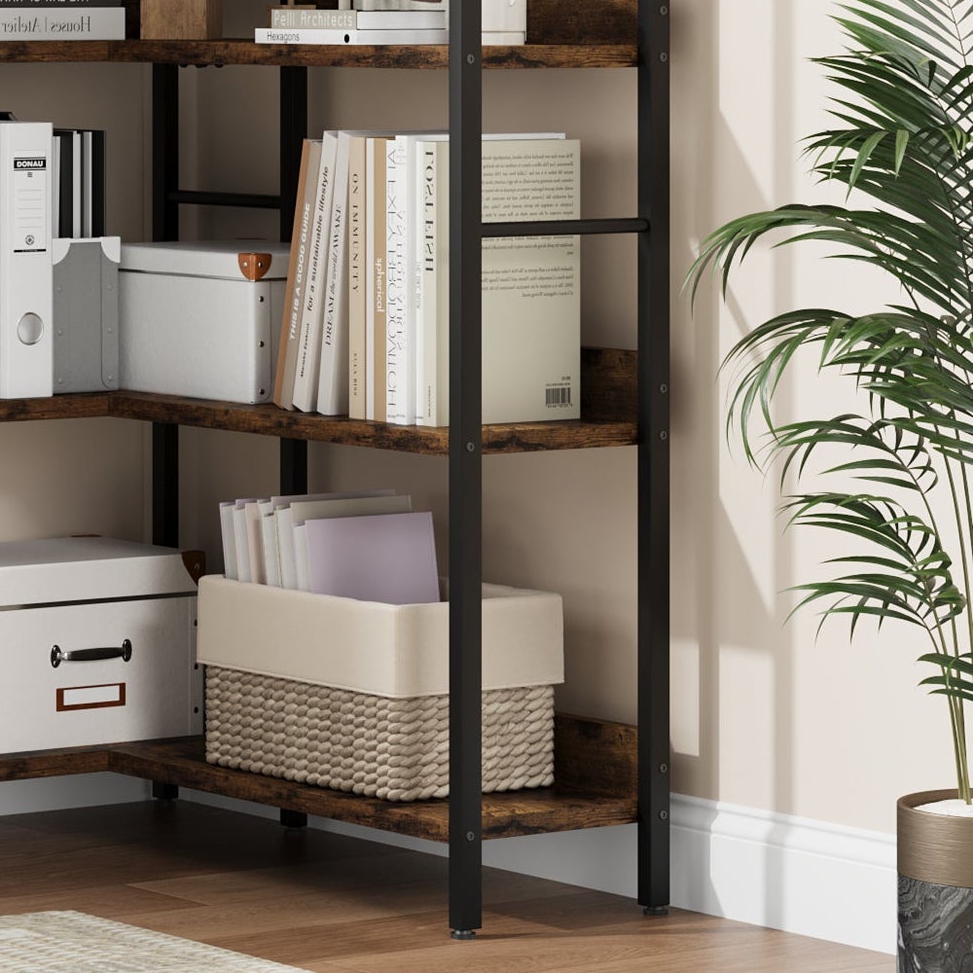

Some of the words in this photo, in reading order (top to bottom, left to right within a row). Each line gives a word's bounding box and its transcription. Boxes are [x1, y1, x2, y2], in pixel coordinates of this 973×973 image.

[274, 11, 296, 26] Pelli
[300, 11, 353, 27] Architects
[266, 32, 300, 44] Hexagons
[317, 166, 329, 213] lifestyle
[352, 173, 358, 195] ON
[300, 202, 310, 243] GUIDE
[311, 215, 323, 281] sustainable
[296, 245, 306, 283] GOOD
[293, 287, 301, 297] A
[309, 285, 316, 293] a
[377, 258, 386, 313] spherical
[291, 298, 300, 311] IS
[306, 295, 314, 312] for
[289, 312, 298, 341] THIS
[325, 296, 335, 346] DREAM
